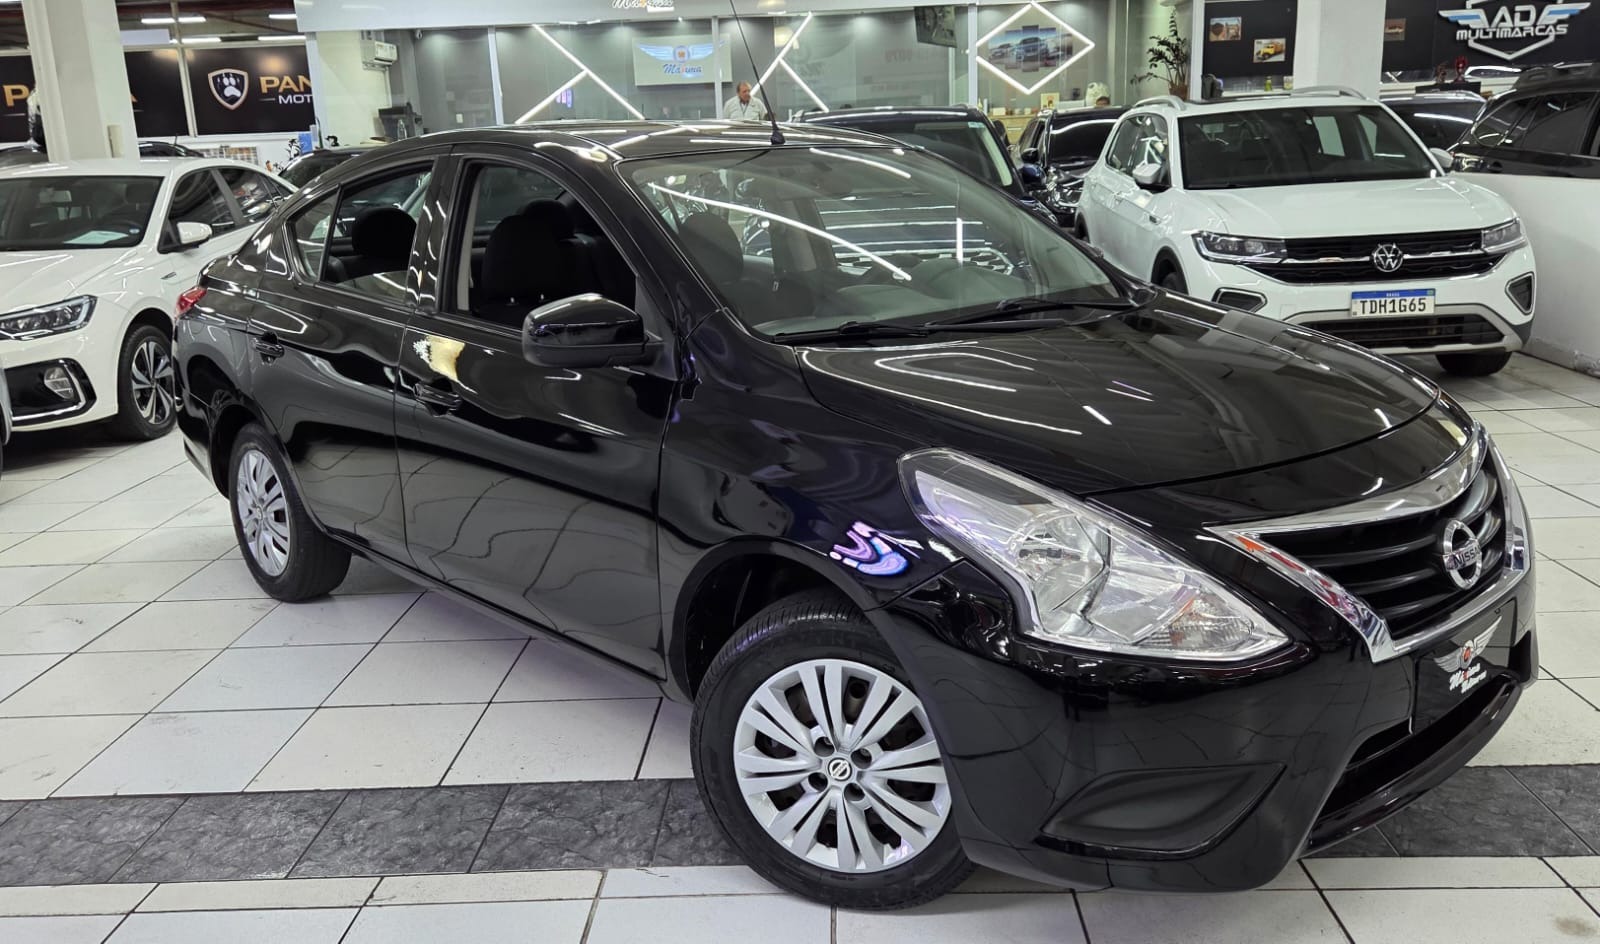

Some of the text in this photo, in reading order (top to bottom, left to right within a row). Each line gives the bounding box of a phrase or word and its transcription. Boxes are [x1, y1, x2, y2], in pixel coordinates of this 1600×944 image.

[1456, 24, 1569, 40] MULTIMARCAS
[260, 75, 312, 94] PAN
[278, 94, 313, 104] MOT
[1360, 298, 1426, 314] TDH1G65
